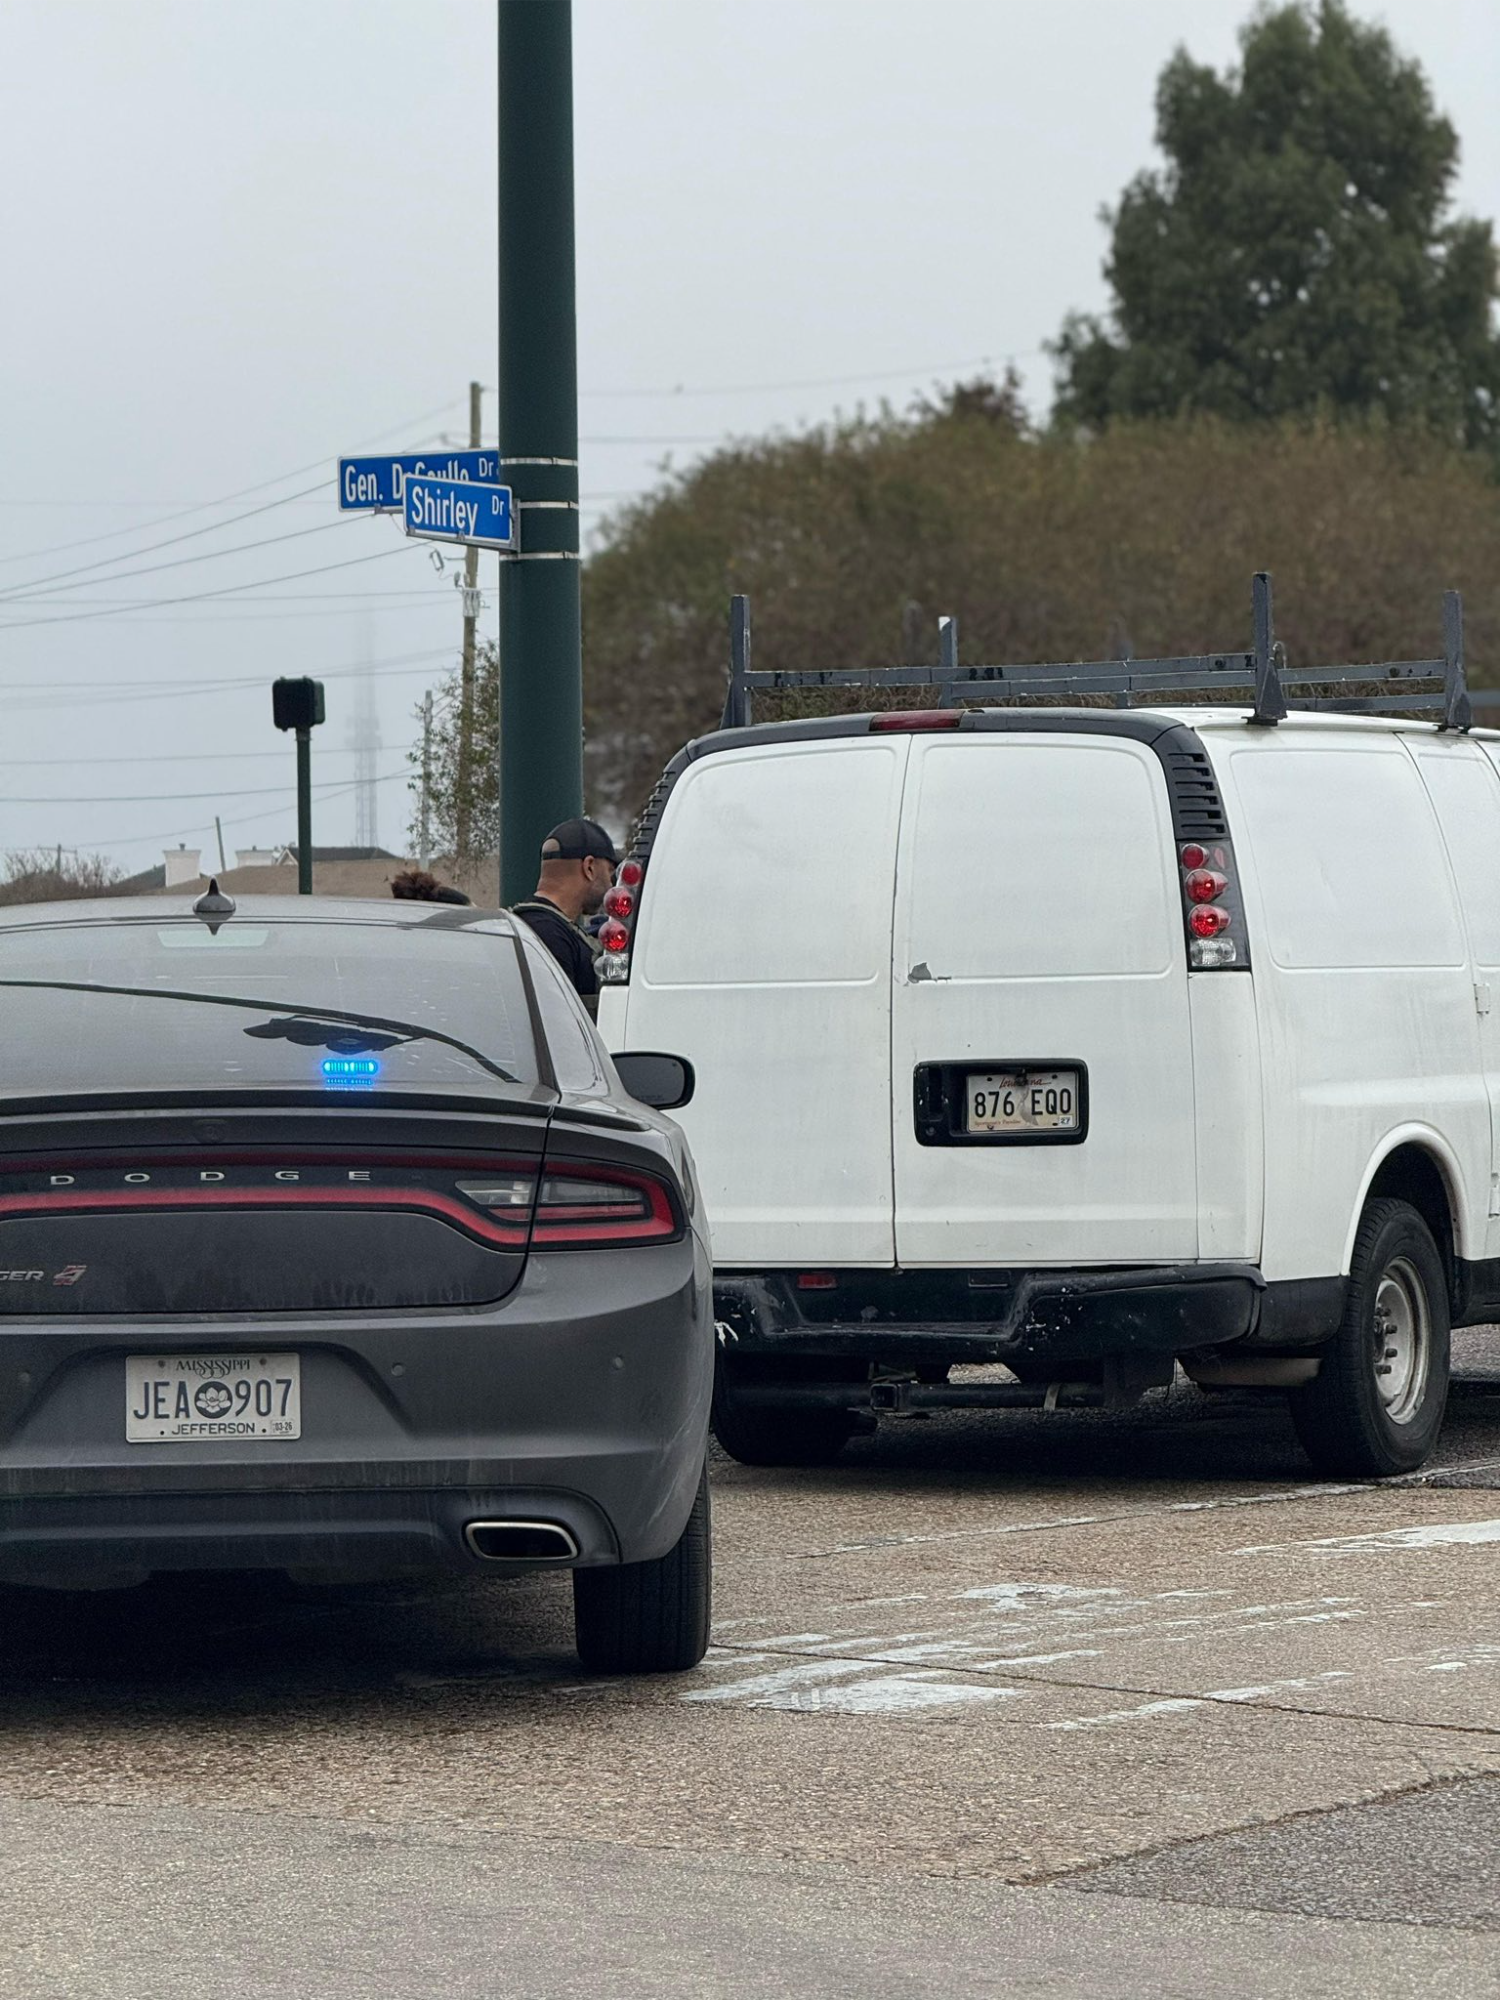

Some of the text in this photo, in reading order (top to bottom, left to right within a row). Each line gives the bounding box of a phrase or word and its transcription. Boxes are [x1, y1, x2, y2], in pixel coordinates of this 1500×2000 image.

[345, 465, 383, 502] Gen.
[479, 458, 494, 477] Dr
[412, 486, 504, 537] Shirley Dr
[974, 1091, 1015, 1118] 876
[1060, 1117, 1070, 1125] 27
[50, 1170, 371, 1186] DODGE
[176, 1358, 250, 1379] MISSISSIPPI
[133, 1379, 292, 1419] JEA 907
[172, 1423, 255, 1435] JEFFERSON
